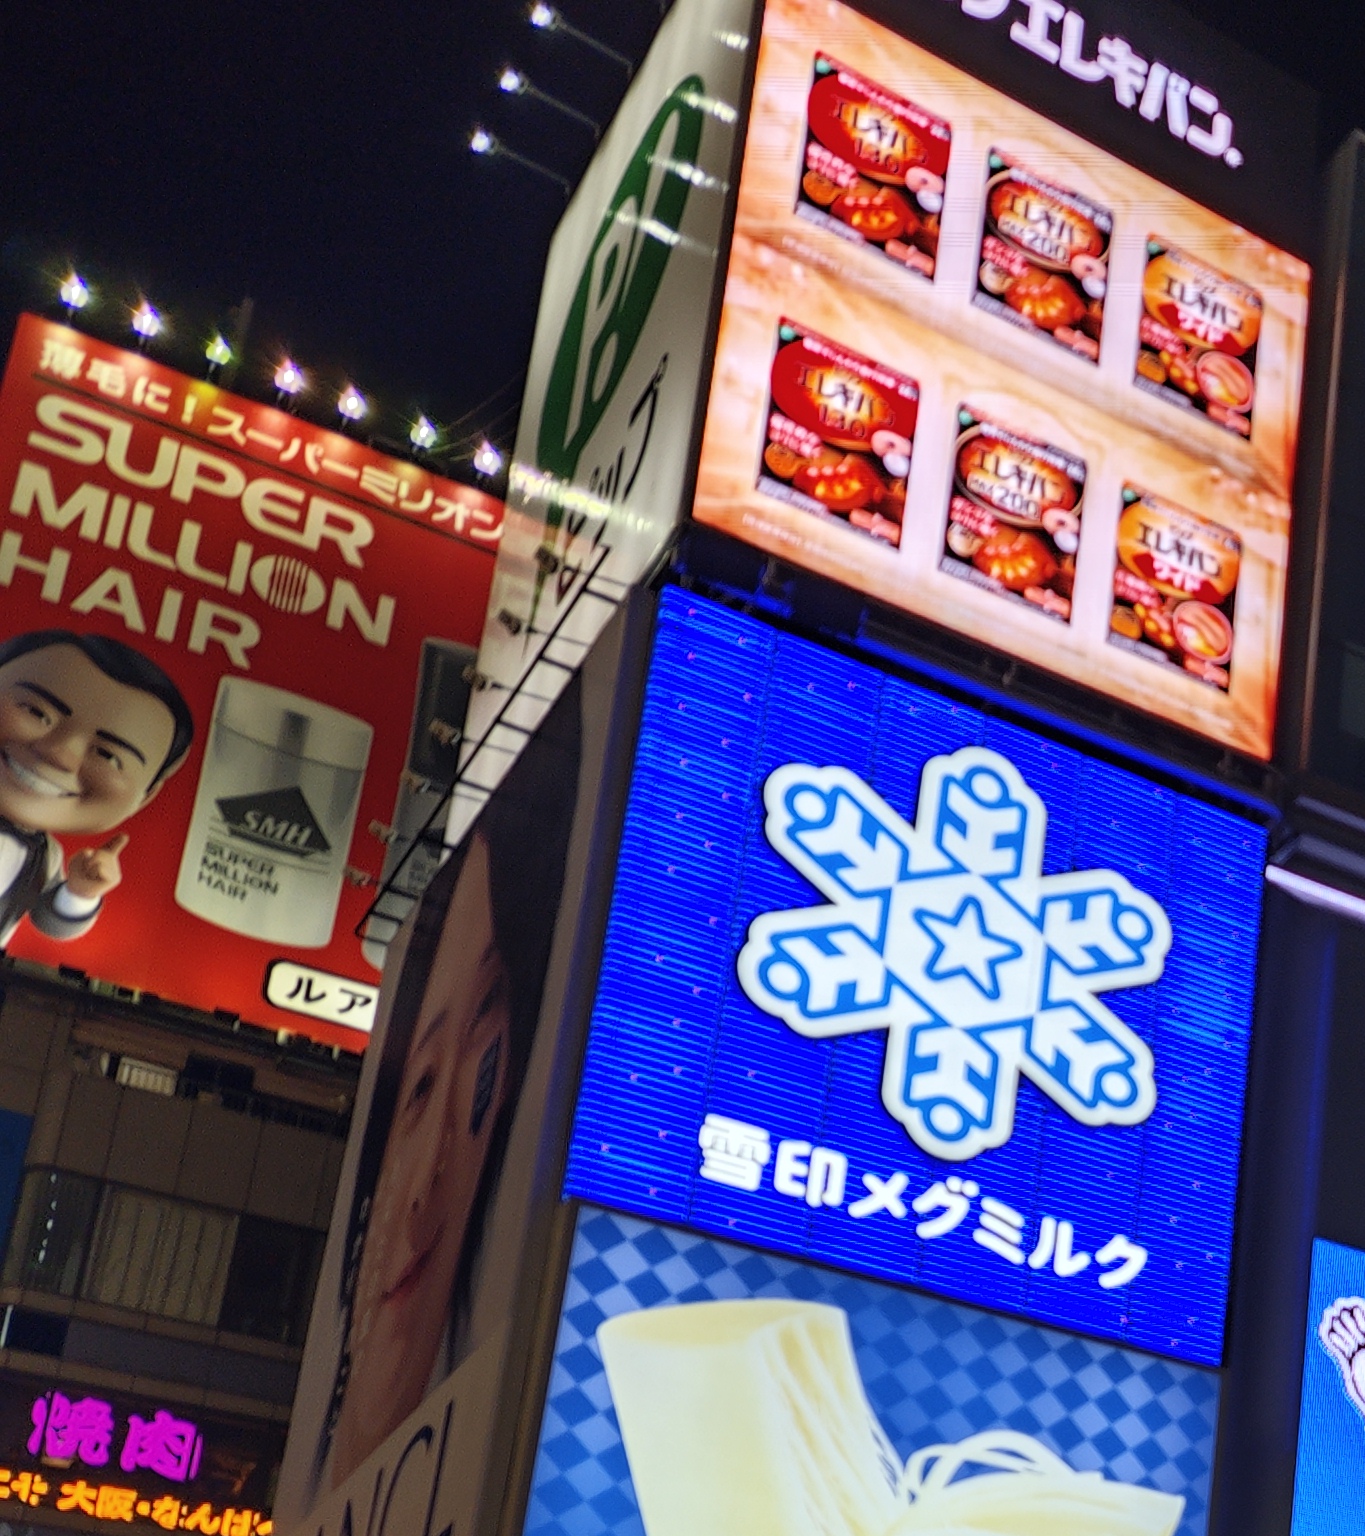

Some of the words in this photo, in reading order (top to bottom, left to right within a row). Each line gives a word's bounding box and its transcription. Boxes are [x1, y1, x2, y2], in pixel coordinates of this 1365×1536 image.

[961, 0, 1243, 168] エレキバン
[28, 394, 375, 570] SUPER
[0, 529, 262, 671] HAIR
[10, 459, 396, 648] MILLION
[197, 870, 250, 902] HAIR
[201, 856, 280, 896] MILLION
[205, 840, 276, 876] SUPER
[243, 808, 314, 850] SMH
[698, 1113, 1148, 1290] 雪印メグミルク
